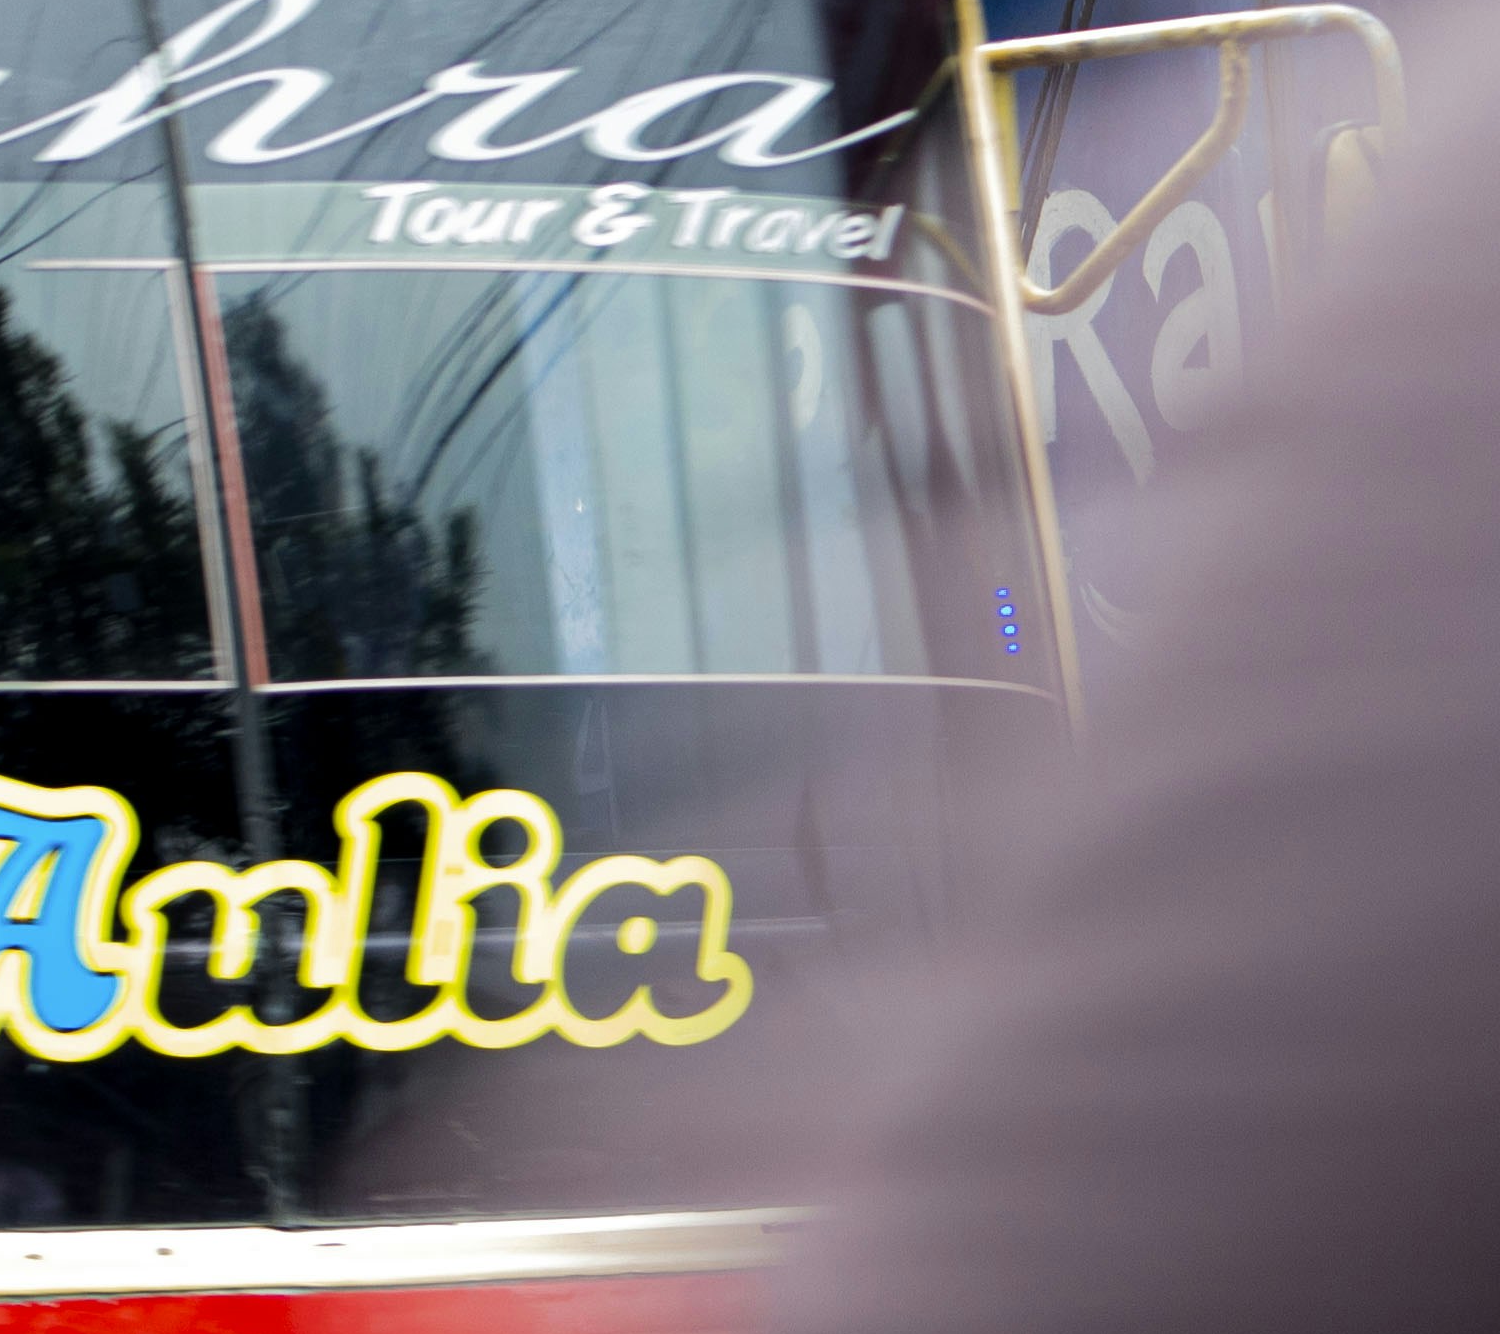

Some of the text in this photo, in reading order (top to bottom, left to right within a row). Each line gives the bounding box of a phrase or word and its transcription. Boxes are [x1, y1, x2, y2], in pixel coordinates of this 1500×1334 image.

[361, 179, 905, 262] Tour & Travel
